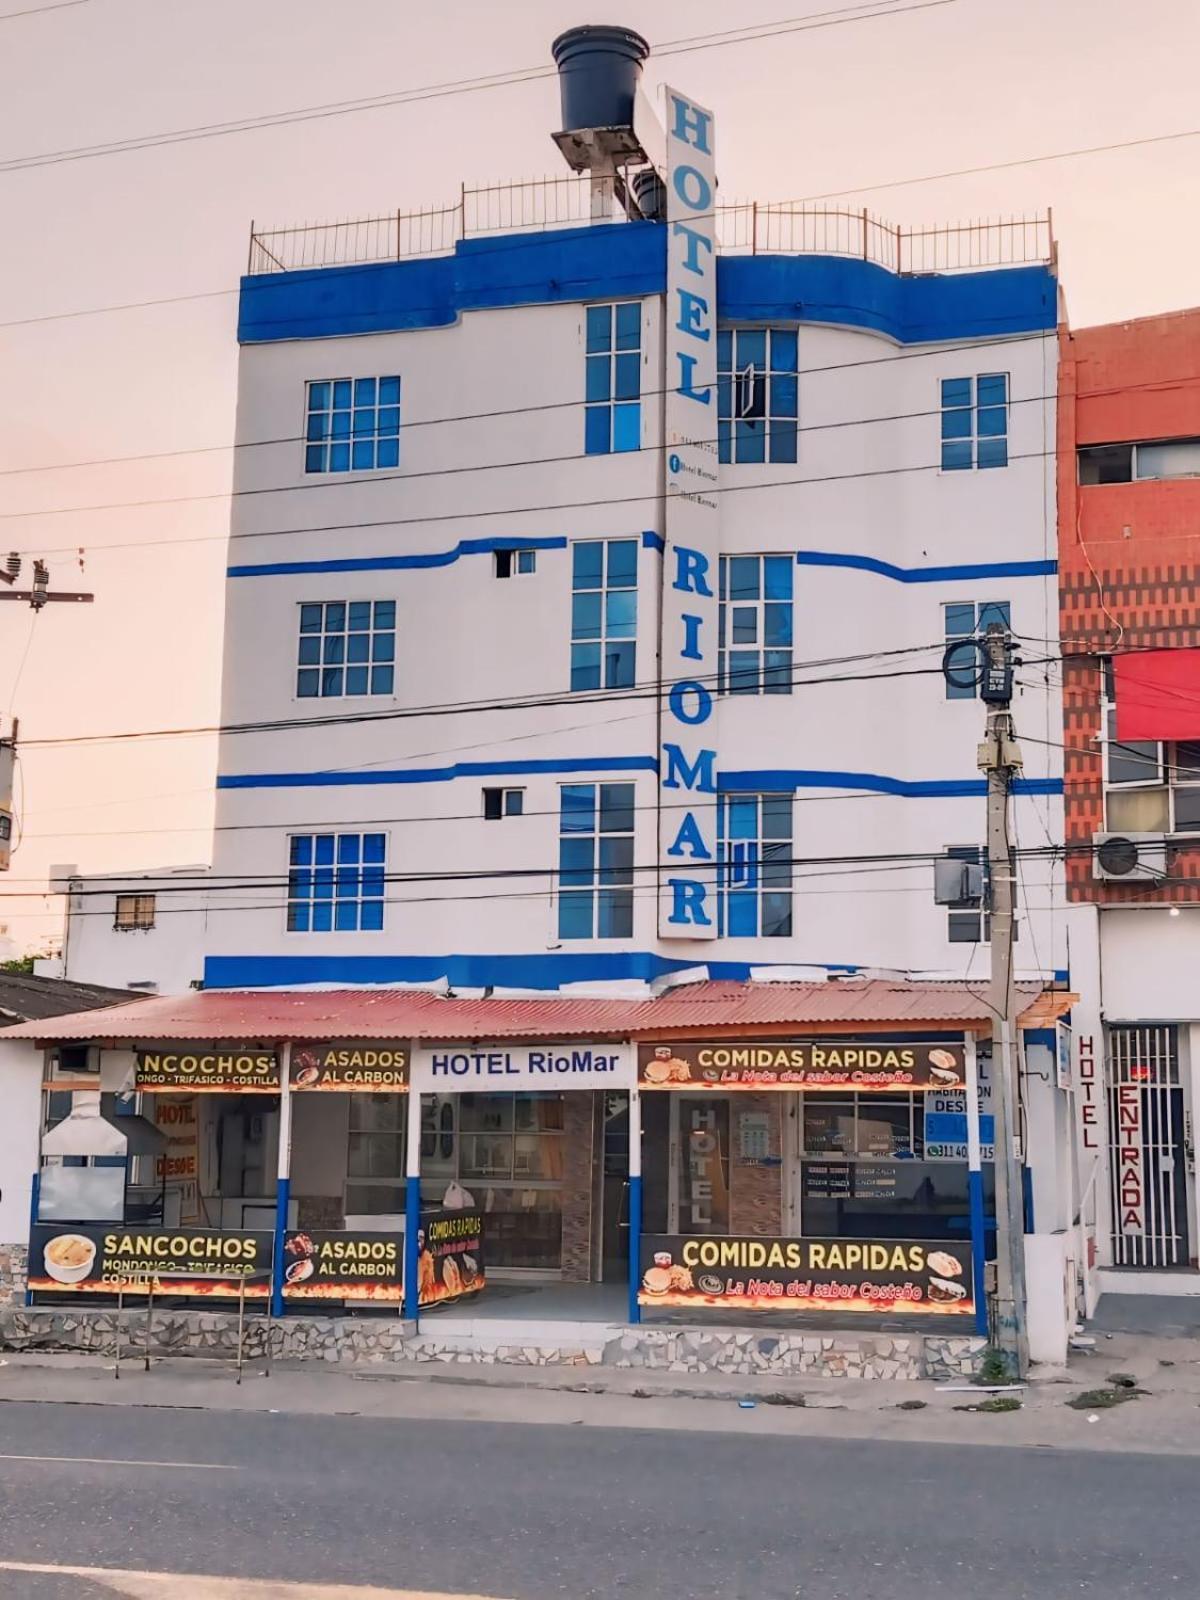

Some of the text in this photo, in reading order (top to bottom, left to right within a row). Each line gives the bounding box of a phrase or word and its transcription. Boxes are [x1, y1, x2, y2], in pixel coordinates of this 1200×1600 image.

[671, 94, 713, 405] HOTEL
[662, 545, 718, 926] RIOMAR
[136, 1055, 269, 1074] NCOCHOS
[324, 1051, 405, 1067] ASADOS
[432, 1051, 620, 1076] HOTEL RioMar
[698, 1049, 914, 1068] COMIDAS RAPIDAS
[137, 1074, 165, 1083] ONGO
[174, 1074, 224, 1085] TRIFASICO
[232, 1075, 279, 1085] COSTILLA
[321, 1071, 404, 1084] AL CARBON
[720, 1070, 914, 1083] La Nota del sabor Costeño
[928, 1086, 991, 1097] HABITAON
[1079, 1035, 1098, 1148] HOTEL
[935, 1101, 984, 1113] DESE
[1119, 1085, 1142, 1228] ENTRADA
[690, 1110, 716, 1224] HOTEL
[104, 1234, 257, 1258] SANCOCHOS
[320, 1241, 396, 1259] ASADOS
[683, 1241, 924, 1272] COMIDAS RAPIDAS
[319, 1263, 396, 1276] AL CARBON
[102, 1273, 160, 1286] COSTILLA
[726, 1278, 923, 1300] La Nota del sabor Costeño
